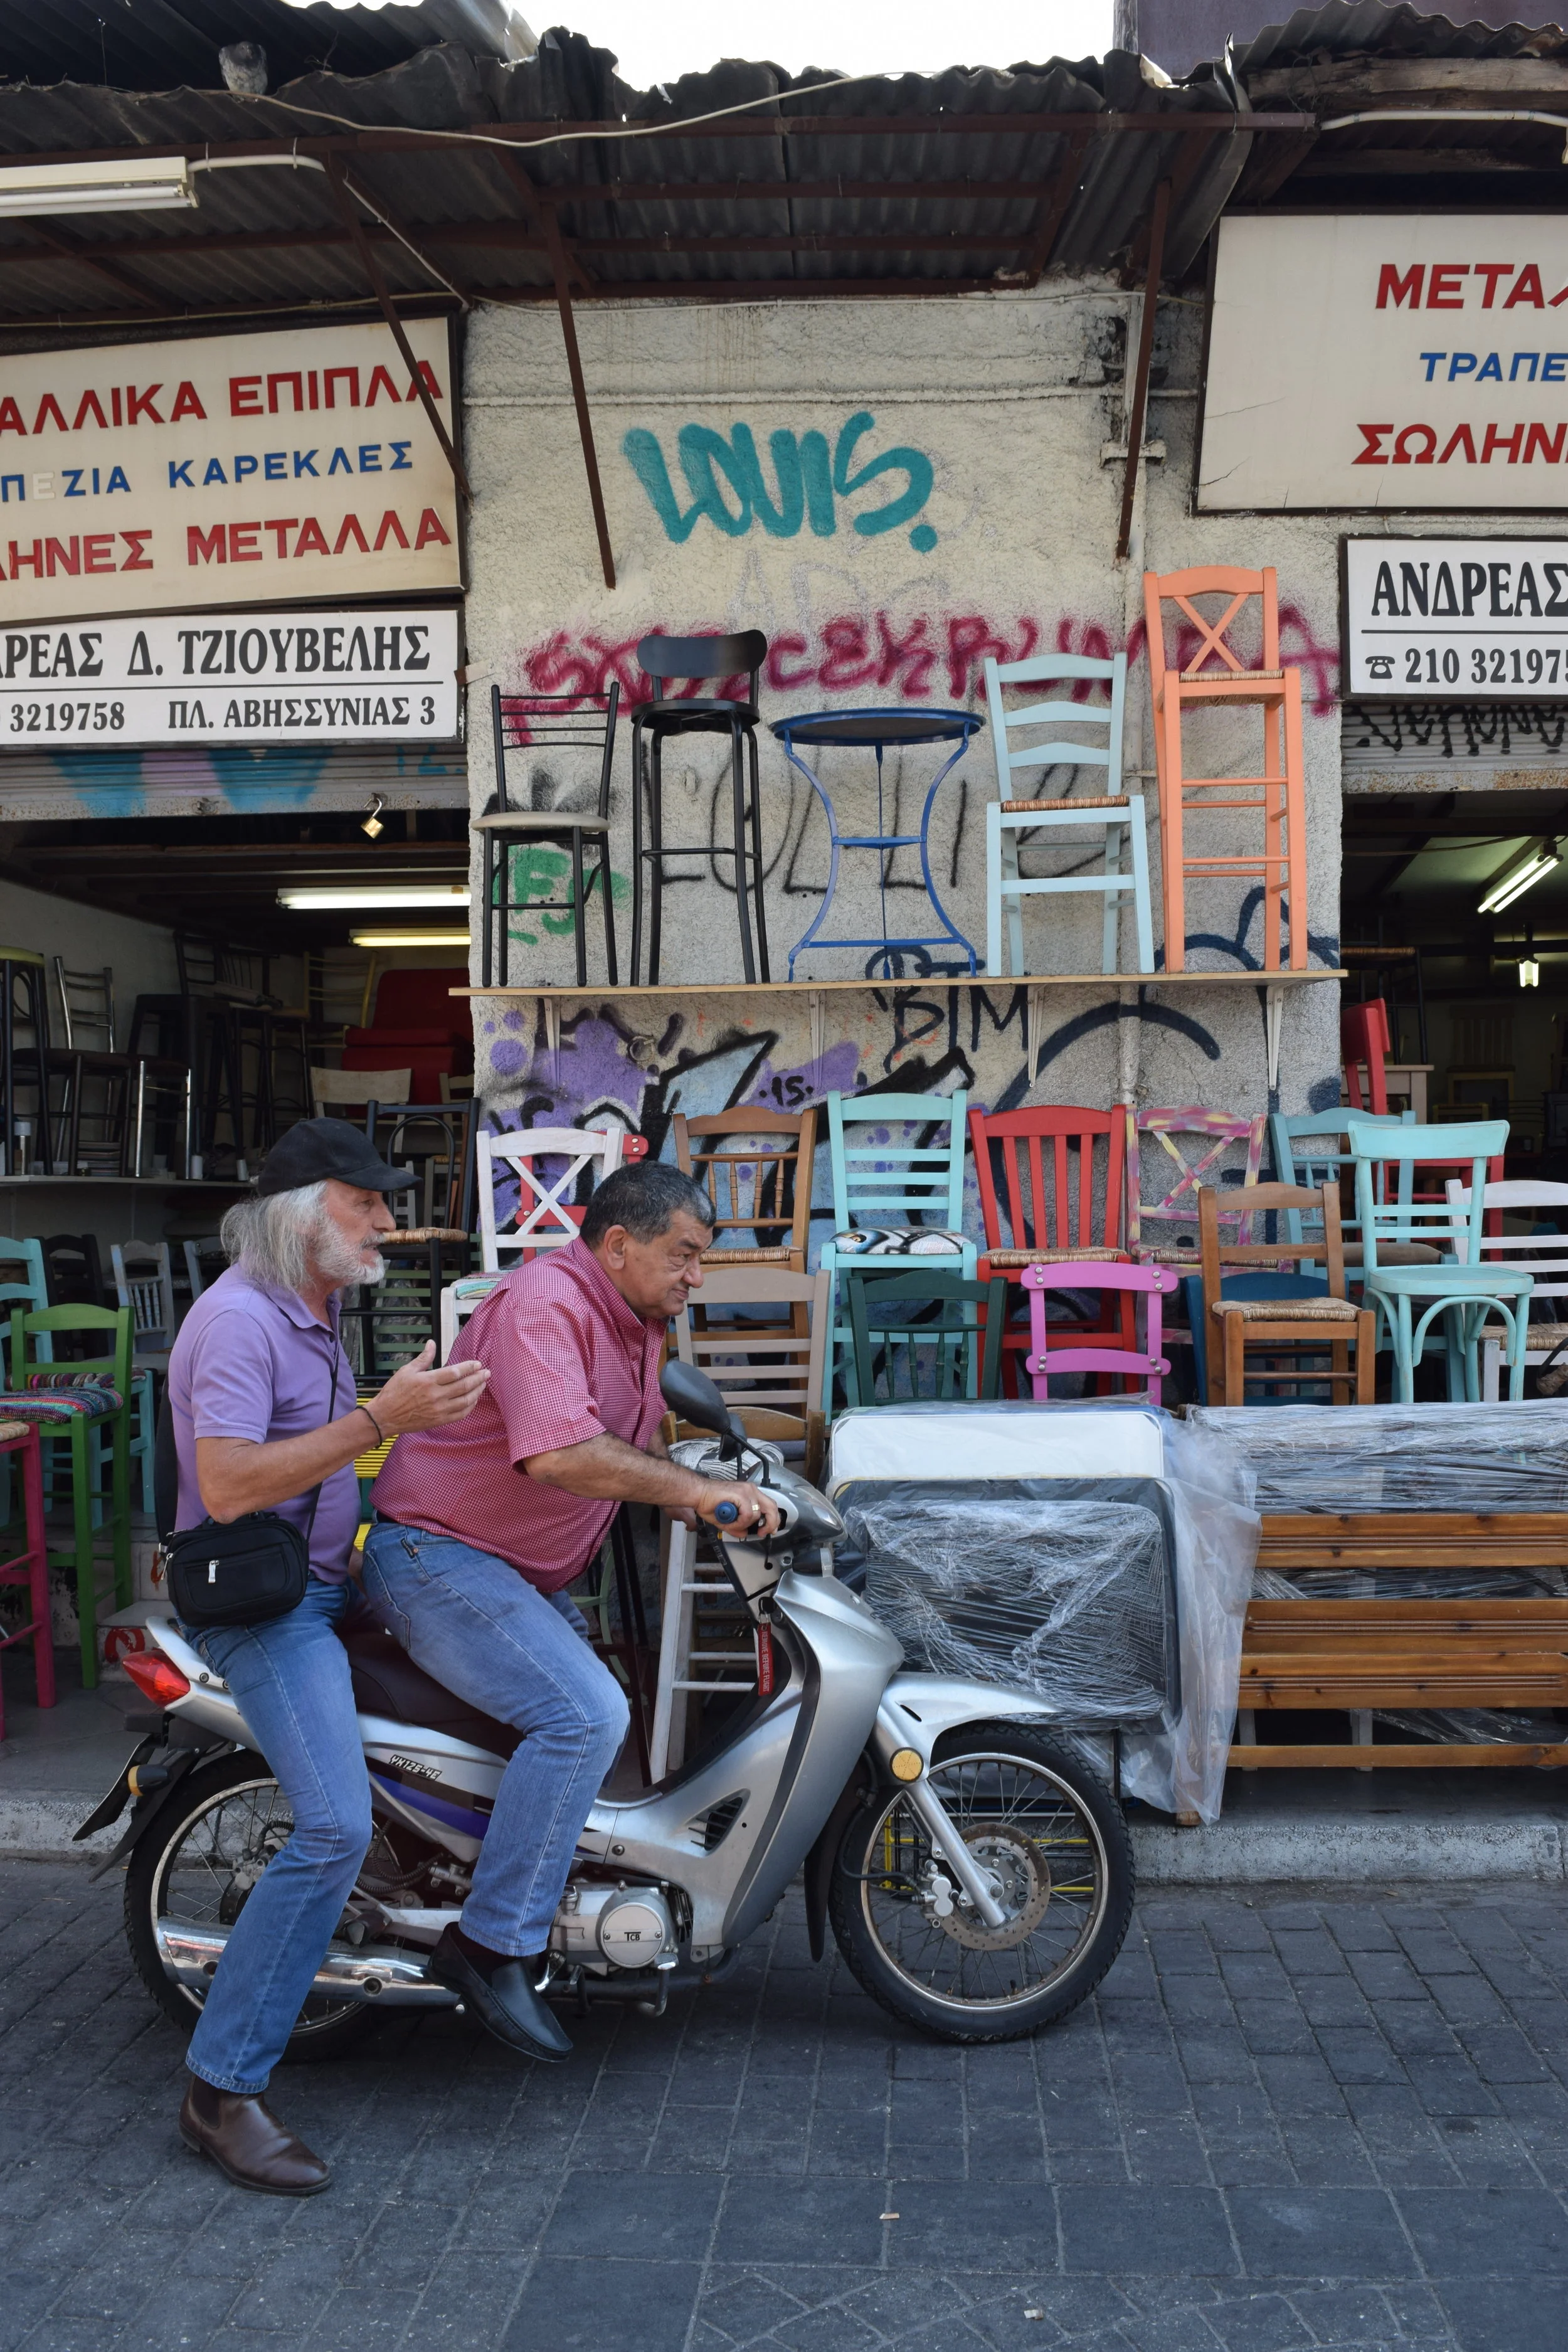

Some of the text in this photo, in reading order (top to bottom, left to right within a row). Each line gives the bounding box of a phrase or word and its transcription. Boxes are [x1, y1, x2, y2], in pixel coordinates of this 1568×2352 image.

[1420, 352, 1568, 382] ΤΡΑΠΕ
[0, 360, 443, 435] ΑΛΛΙΚΑ ΕΠΙΠΛΑ
[1352, 422, 1568, 465] ΣΩΛΗΝ
[1, 442, 413, 502] ΠΕΖΙΑ ΚΑΡΕΚΛΕΣ
[0, 508, 452, 581] ΗΝΕΣ ΜΕΤΑΛΛΑ
[1371, 561, 1568, 618] ΑΝΔΡΕΑΣ
[0, 625, 430, 679] ΡΕΑΣ Δ. ΤΖΙΟΥΒΕΛΗΣ
[1404, 647, 1568, 684] 210 32197
[9, 696, 435, 733] 3219758 ΠΛ. ΑΒΗΣΣΥΝΙΑΣ 3
[624, 1932, 641, 1941] TCB
